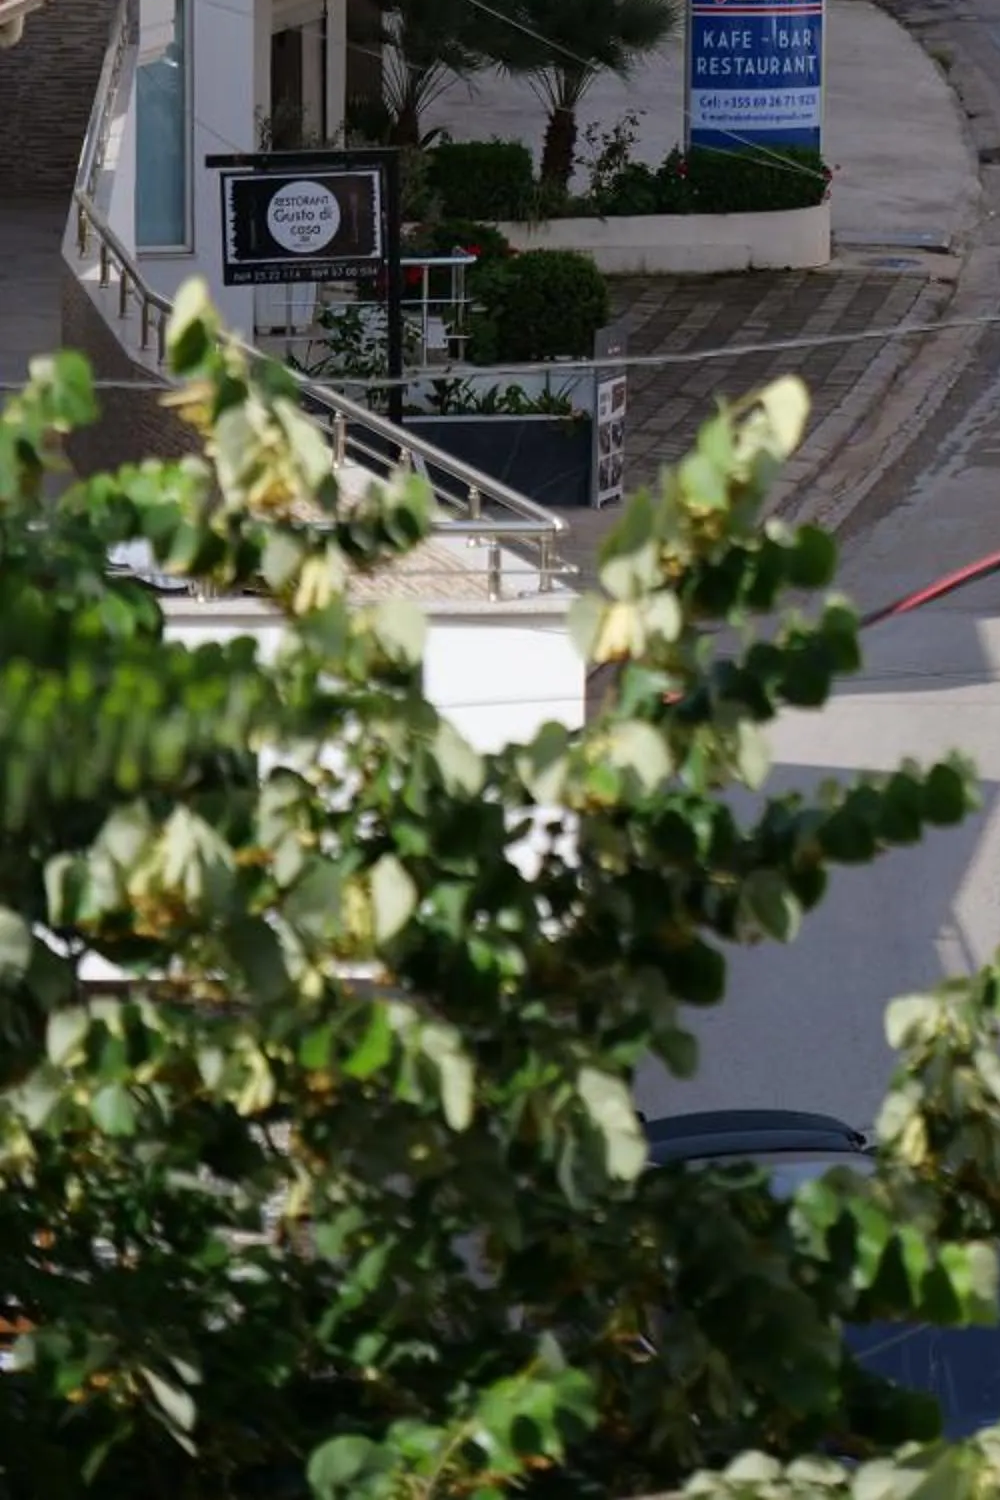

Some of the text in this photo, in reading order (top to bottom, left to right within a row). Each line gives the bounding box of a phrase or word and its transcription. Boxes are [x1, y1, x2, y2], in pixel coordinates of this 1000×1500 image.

[703, 28, 752, 49] KAFE
[779, 28, 812, 48] BAR
[697, 55, 817, 76] RESTAURANT
[273, 206, 332, 223] Gusto di
[290, 225, 321, 236] casa
